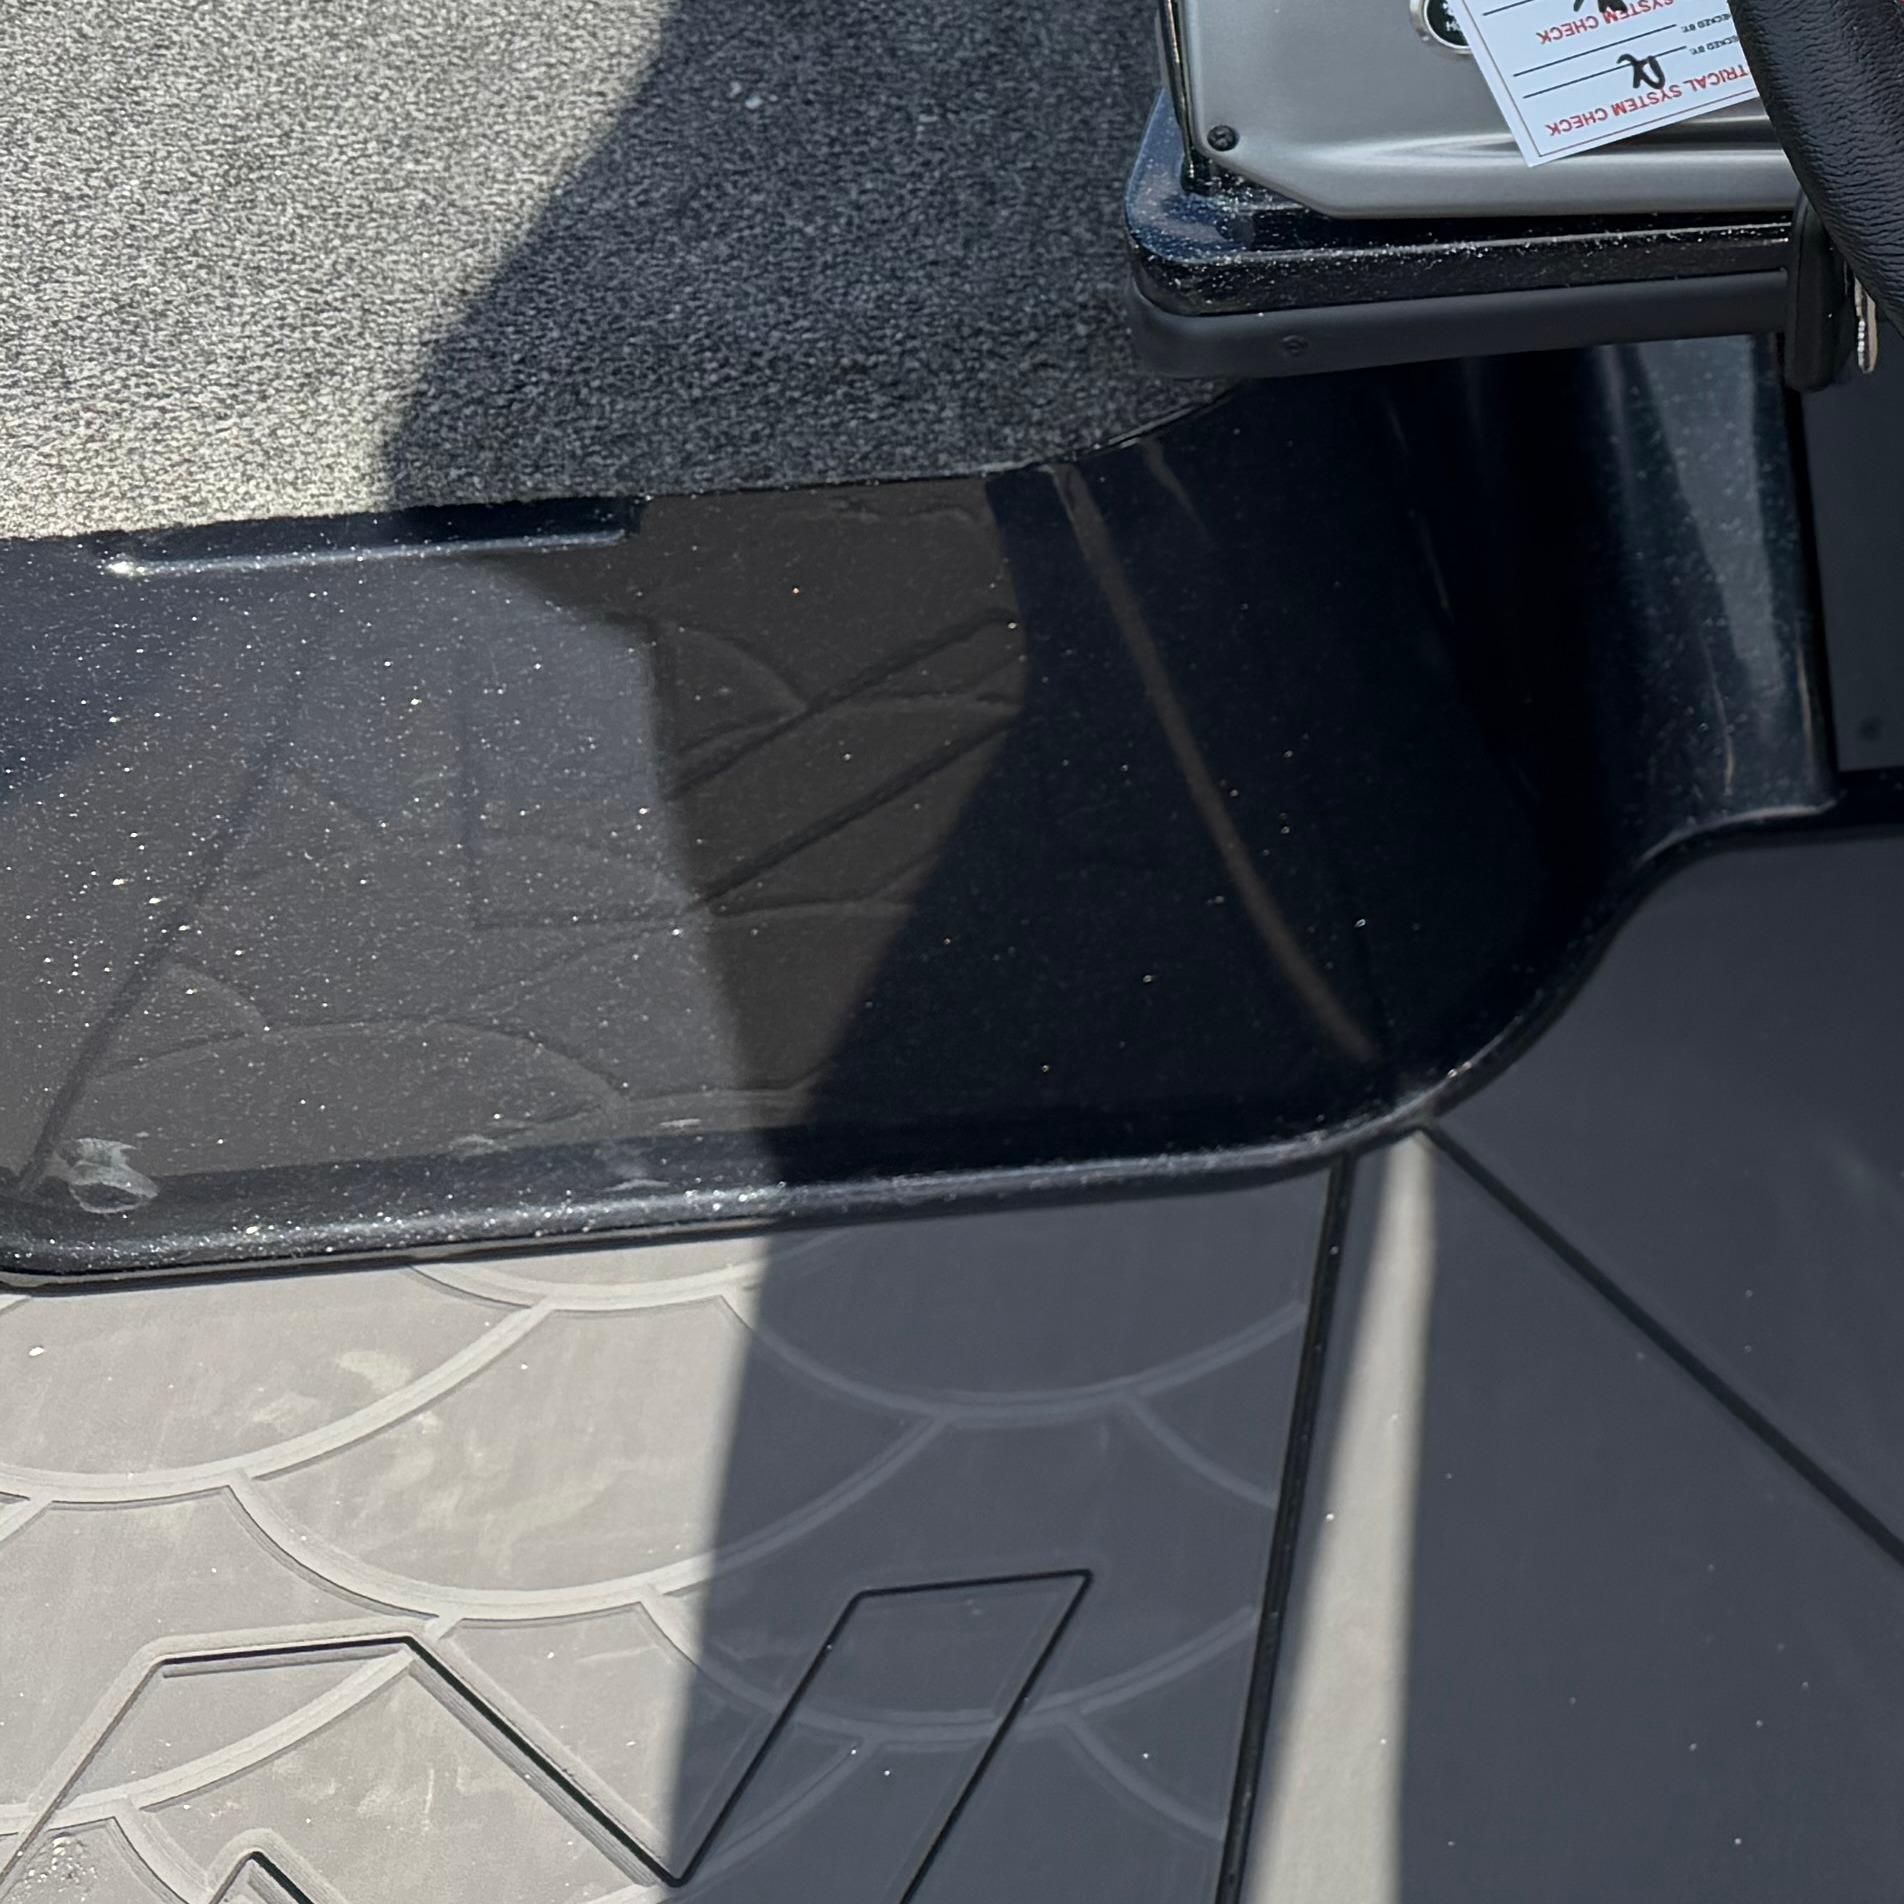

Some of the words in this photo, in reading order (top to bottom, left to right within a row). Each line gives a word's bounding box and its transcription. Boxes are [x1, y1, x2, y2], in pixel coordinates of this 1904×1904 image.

[1536, 15, 1599, 45] CHECK
[1683, 64, 1750, 92] TRICAL
[1611, 84, 1682, 116] SYSTEM
[1544, 108, 1608, 137] CHECK
